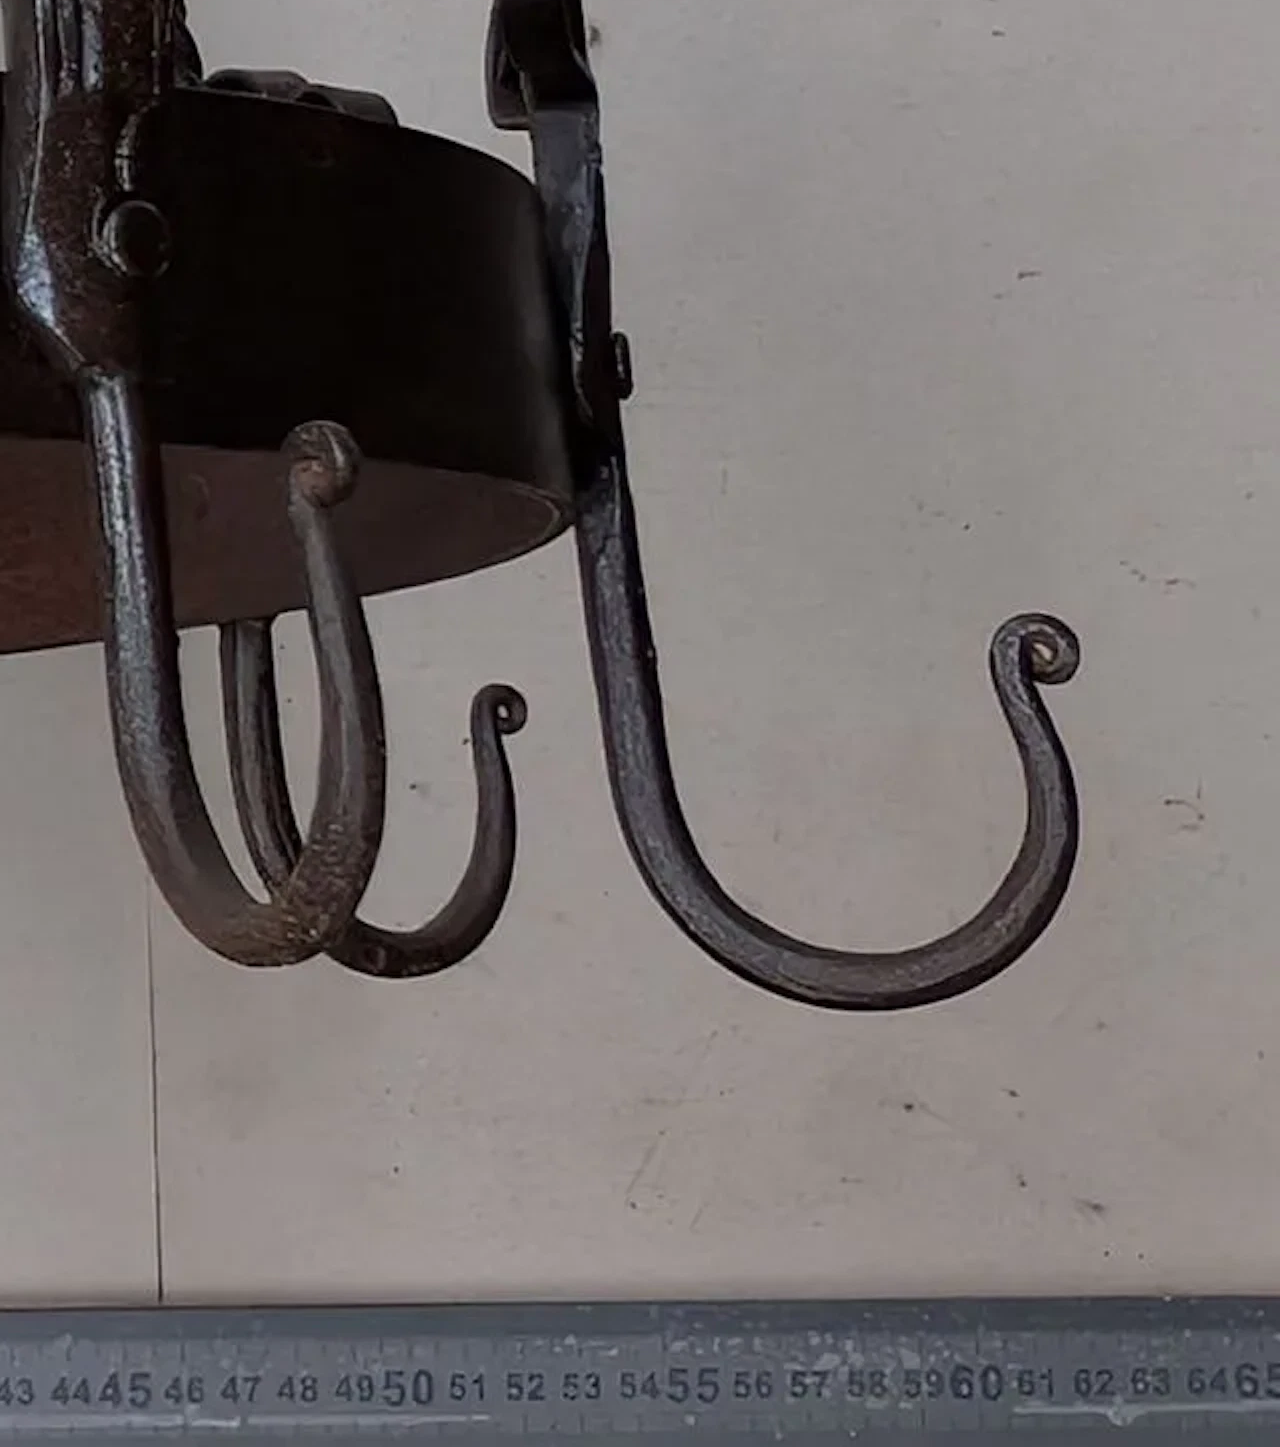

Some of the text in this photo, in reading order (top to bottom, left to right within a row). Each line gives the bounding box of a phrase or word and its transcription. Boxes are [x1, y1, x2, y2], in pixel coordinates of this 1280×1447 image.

[51, 1377, 91, 1405] 44
[98, 1372, 152, 1409] 45
[164, 1376, 205, 1405] 46
[221, 1375, 261, 1404] 47
[277, 1375, 318, 1403] 48
[335, 1374, 375, 1402] 49
[383, 1369, 434, 1407] 50
[450, 1373, 484, 1402] 51
[507, 1373, 545, 1401] 52
[563, 1372, 600, 1401] 53
[620, 1372, 661, 1399] 54
[666, 1367, 720, 1404] 55
[734, 1370, 775, 1399] 56
[789, 1369, 830, 1397] 57
[845, 1369, 888, 1400] 58
[905, 1369, 943, 1398] 59
[950, 1362, 1005, 1401] 60
[1015, 1369, 1053, 1398] 61
[1074, 1369, 1116, 1399] 62
[1129, 1366, 1170, 1399] 63
[1187, 1367, 1228, 1398] 64
